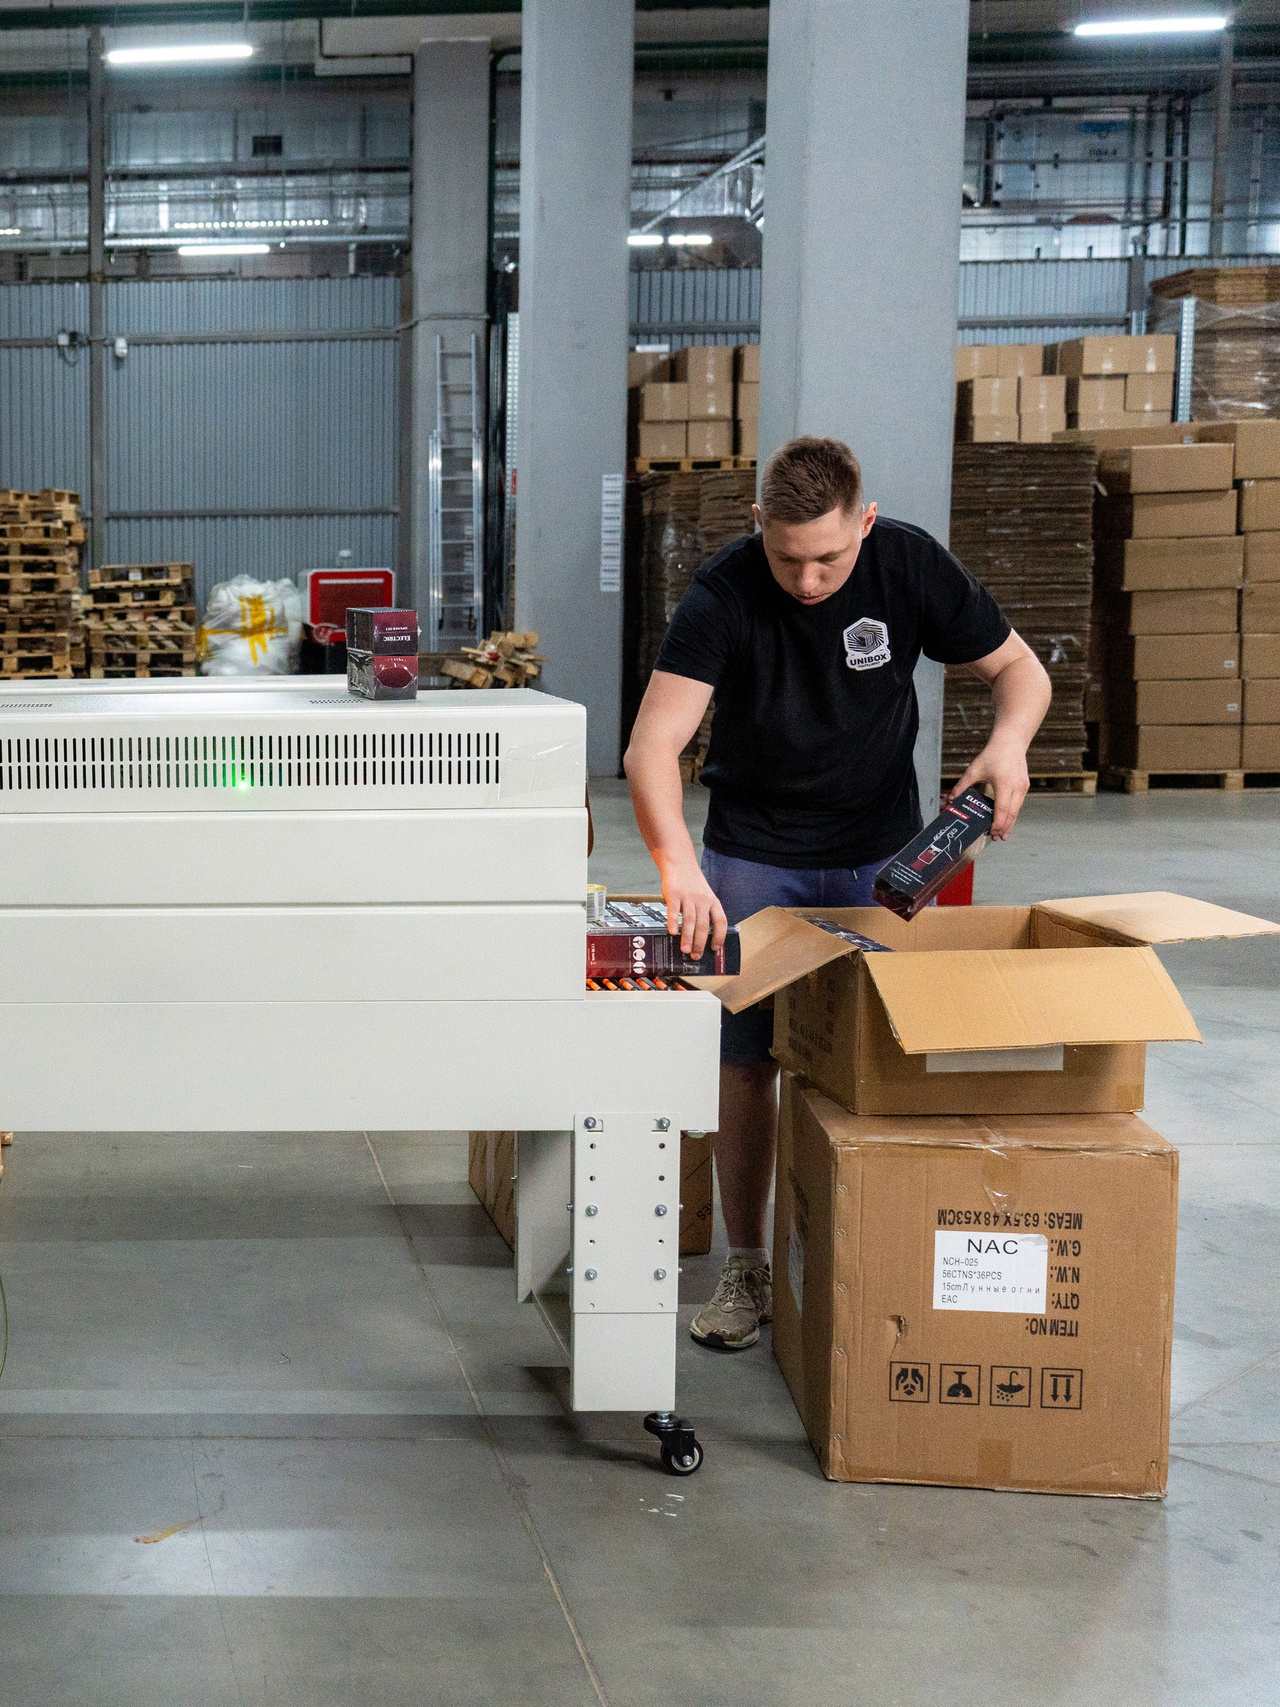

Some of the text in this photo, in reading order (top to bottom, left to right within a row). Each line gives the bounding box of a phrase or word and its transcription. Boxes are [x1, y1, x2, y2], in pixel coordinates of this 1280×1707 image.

[850, 653, 887, 666] UNIBOX
[965, 794, 994, 814] ELECTRIC
[1044, 1212, 1083, 1230] MEAS:
[967, 1238, 1018, 1255] NAC
[1050, 1239, 1081, 1257] G.W.:
[942, 1257, 979, 1267] NCH-025
[1050, 1266, 1080, 1283] N.W.:
[941, 1294, 958, 1304] EAC
[1051, 1292, 1080, 1310] QTY:
[1026, 1317, 1078, 1337] ITEM NO:
